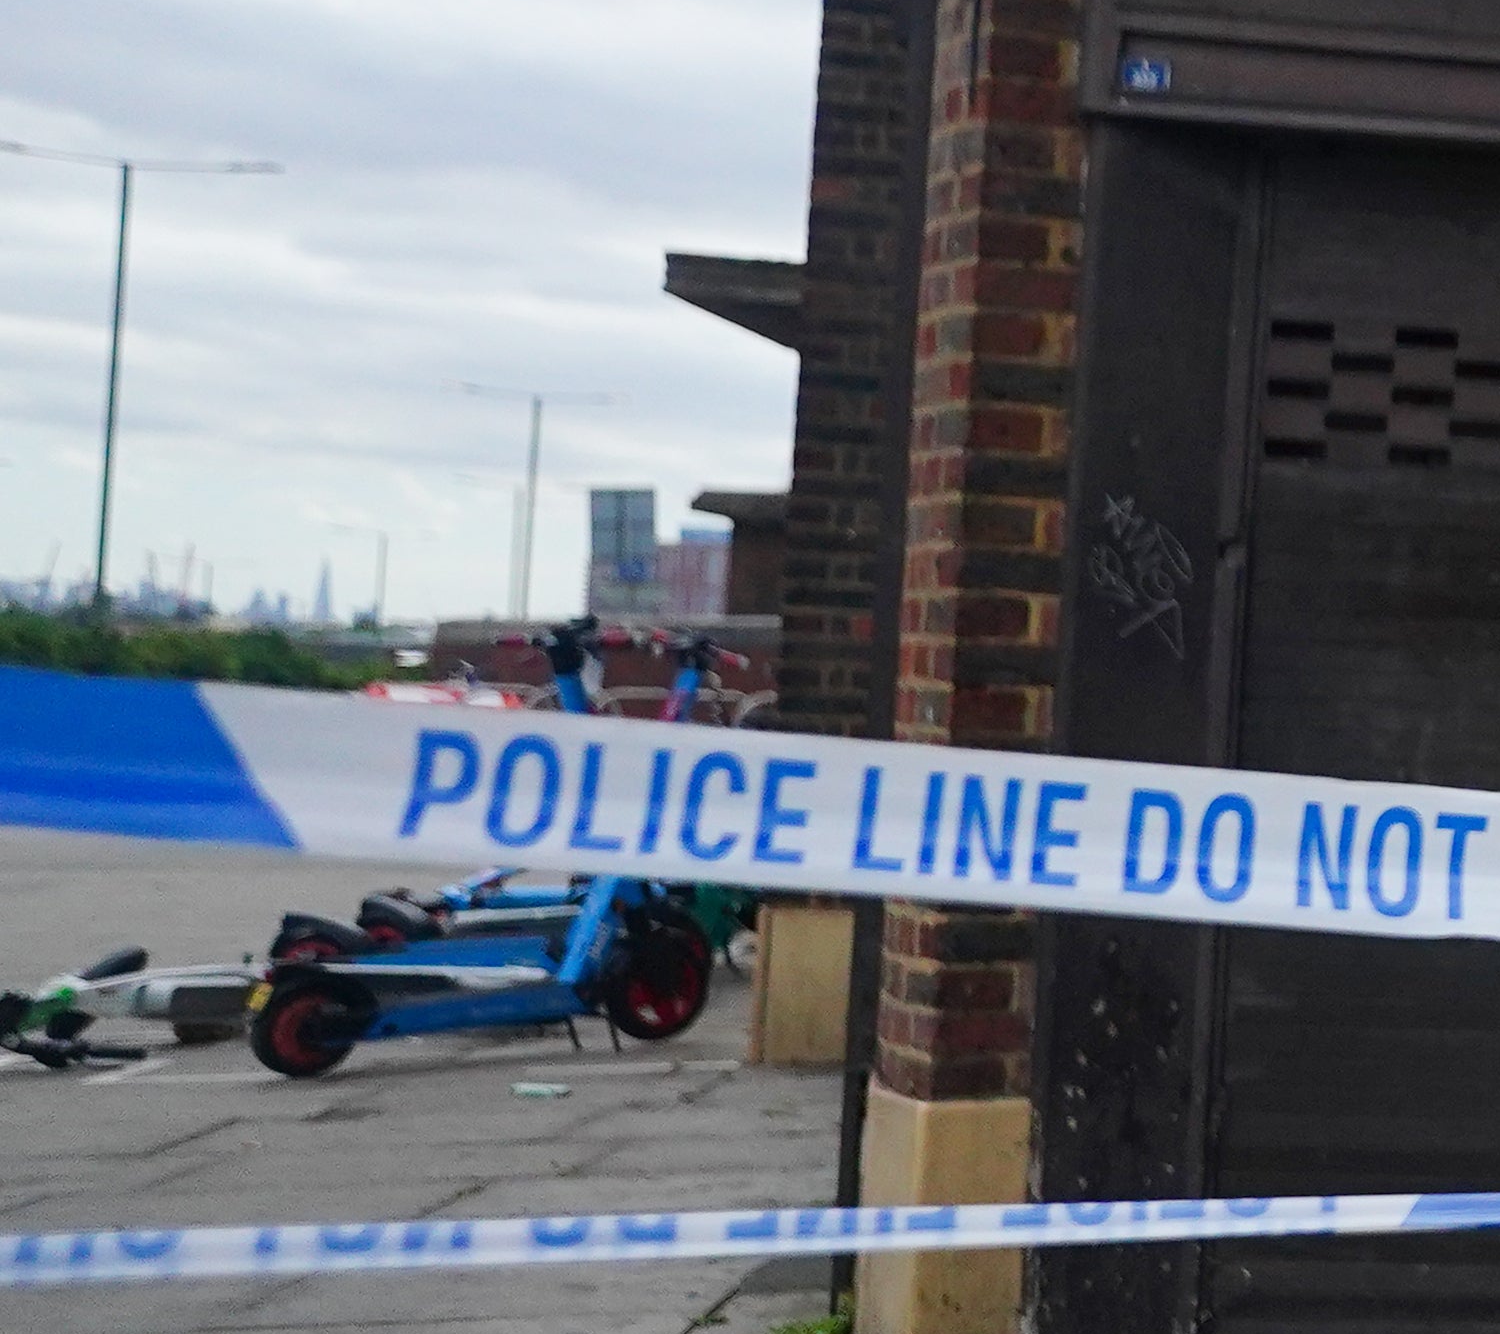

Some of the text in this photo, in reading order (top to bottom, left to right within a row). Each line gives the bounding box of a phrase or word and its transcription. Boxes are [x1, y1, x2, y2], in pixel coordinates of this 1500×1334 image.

[398, 728, 818, 865] POLICE
[852, 766, 1089, 888] LINE
[1121, 787, 1257, 905] DO
[1295, 801, 1489, 921] NOT
